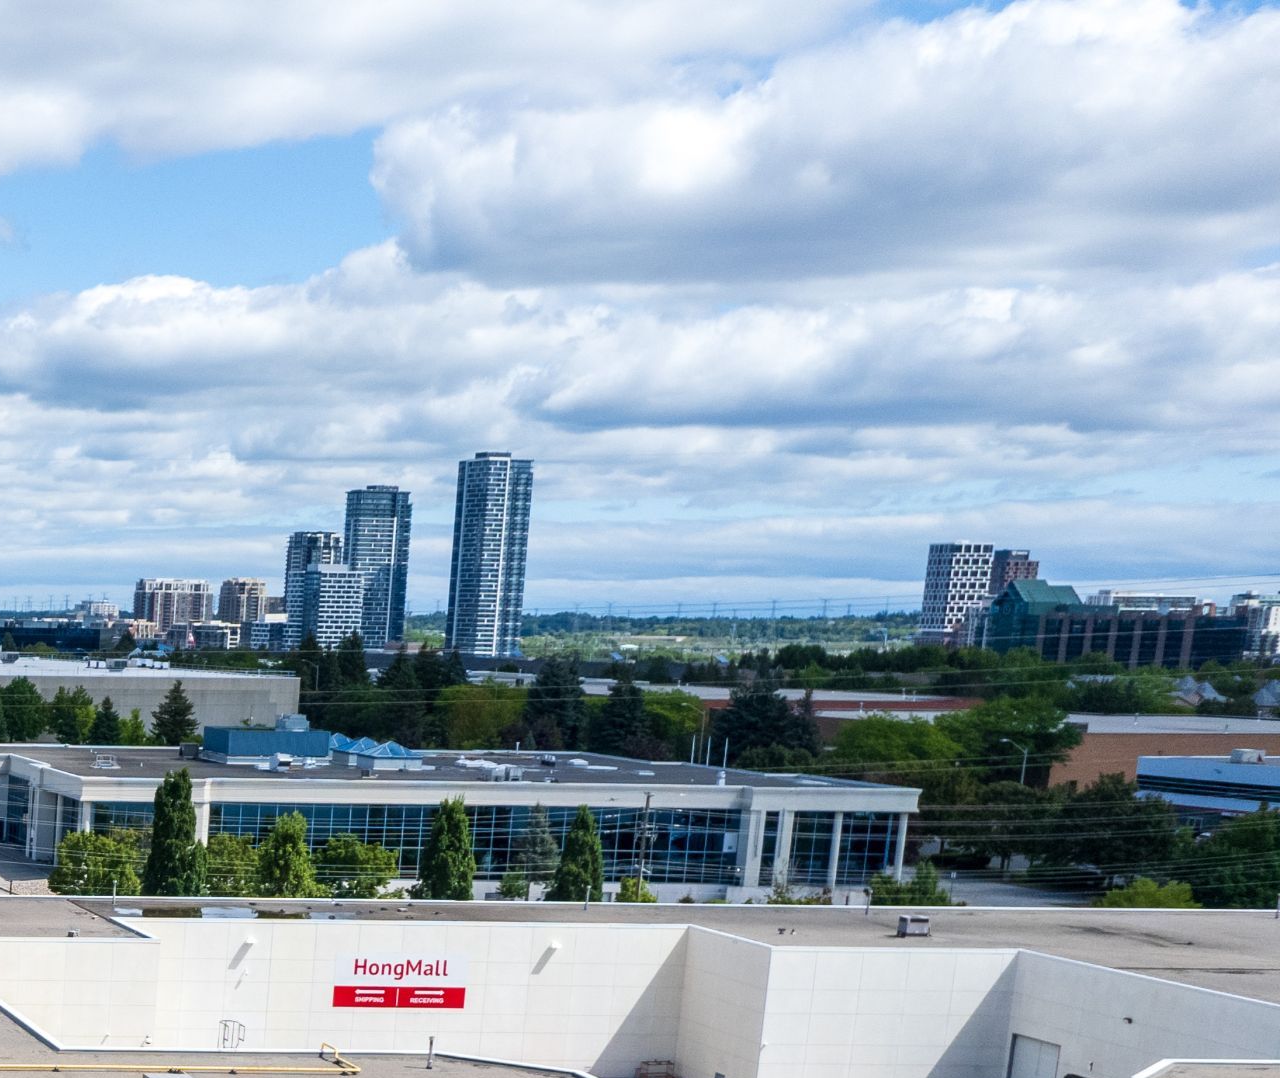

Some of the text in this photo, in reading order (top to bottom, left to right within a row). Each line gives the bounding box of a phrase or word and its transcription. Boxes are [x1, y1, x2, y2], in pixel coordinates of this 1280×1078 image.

[353, 958, 449, 981] HongMall
[354, 996, 385, 1004] SHIPPING
[409, 997, 445, 1005] RECEIVING
